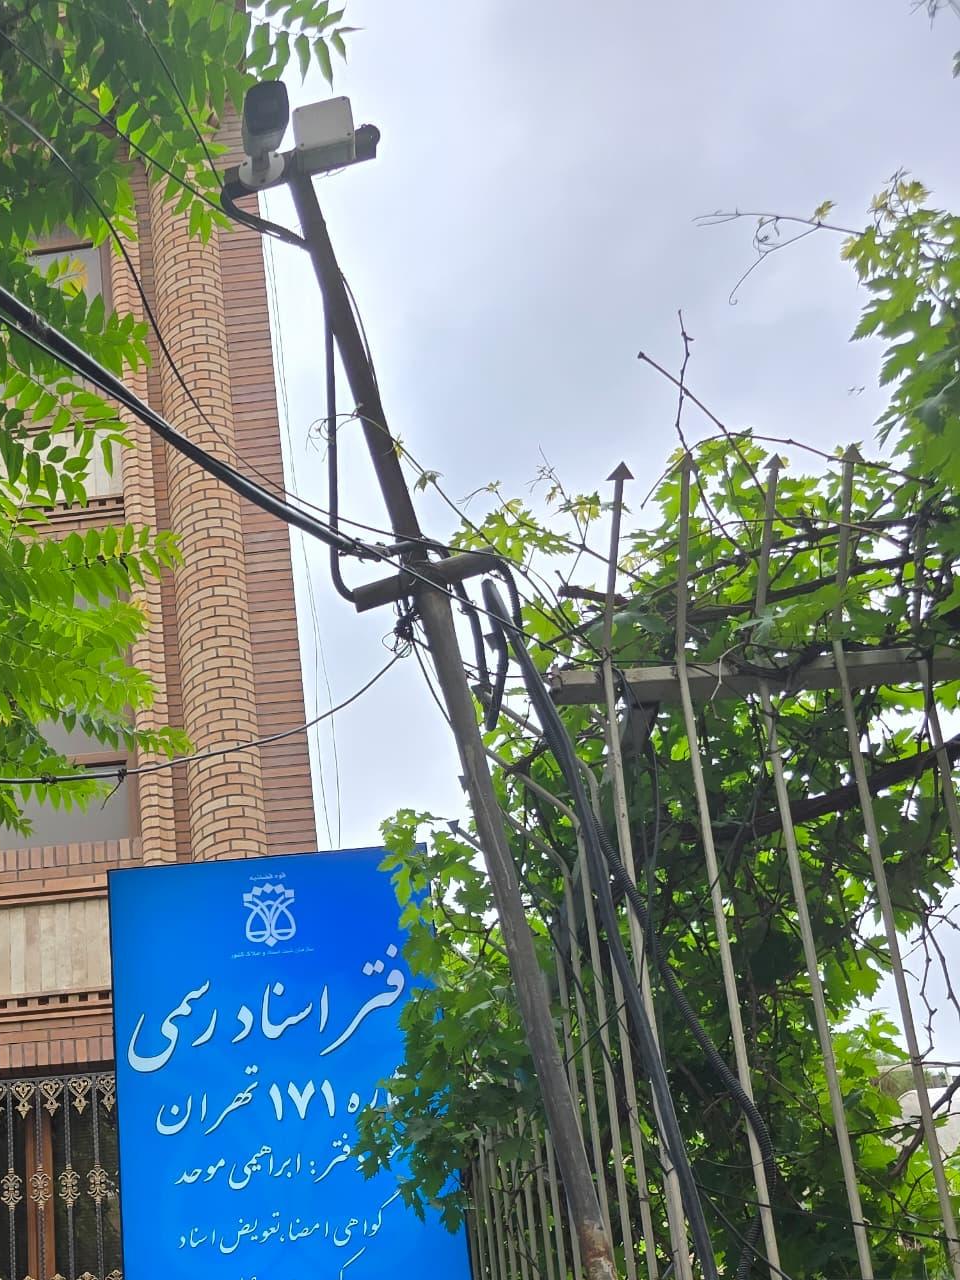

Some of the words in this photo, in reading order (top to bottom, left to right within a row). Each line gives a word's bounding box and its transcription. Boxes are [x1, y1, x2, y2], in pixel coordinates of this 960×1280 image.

[232, 982, 330, 1044] اسناد
[320, 943, 406, 1056] فتر
[127, 979, 217, 1073] رسمی
[155, 1065, 259, 1136] تهران
[269, 1079, 336, 1122] ۱۷۱
[174, 1158, 226, 1185] موحد
[228, 1145, 301, 1190] ابراهیمی
[178, 1227, 216, 1249] اسناد
[219, 1211, 280, 1254] تعویض
